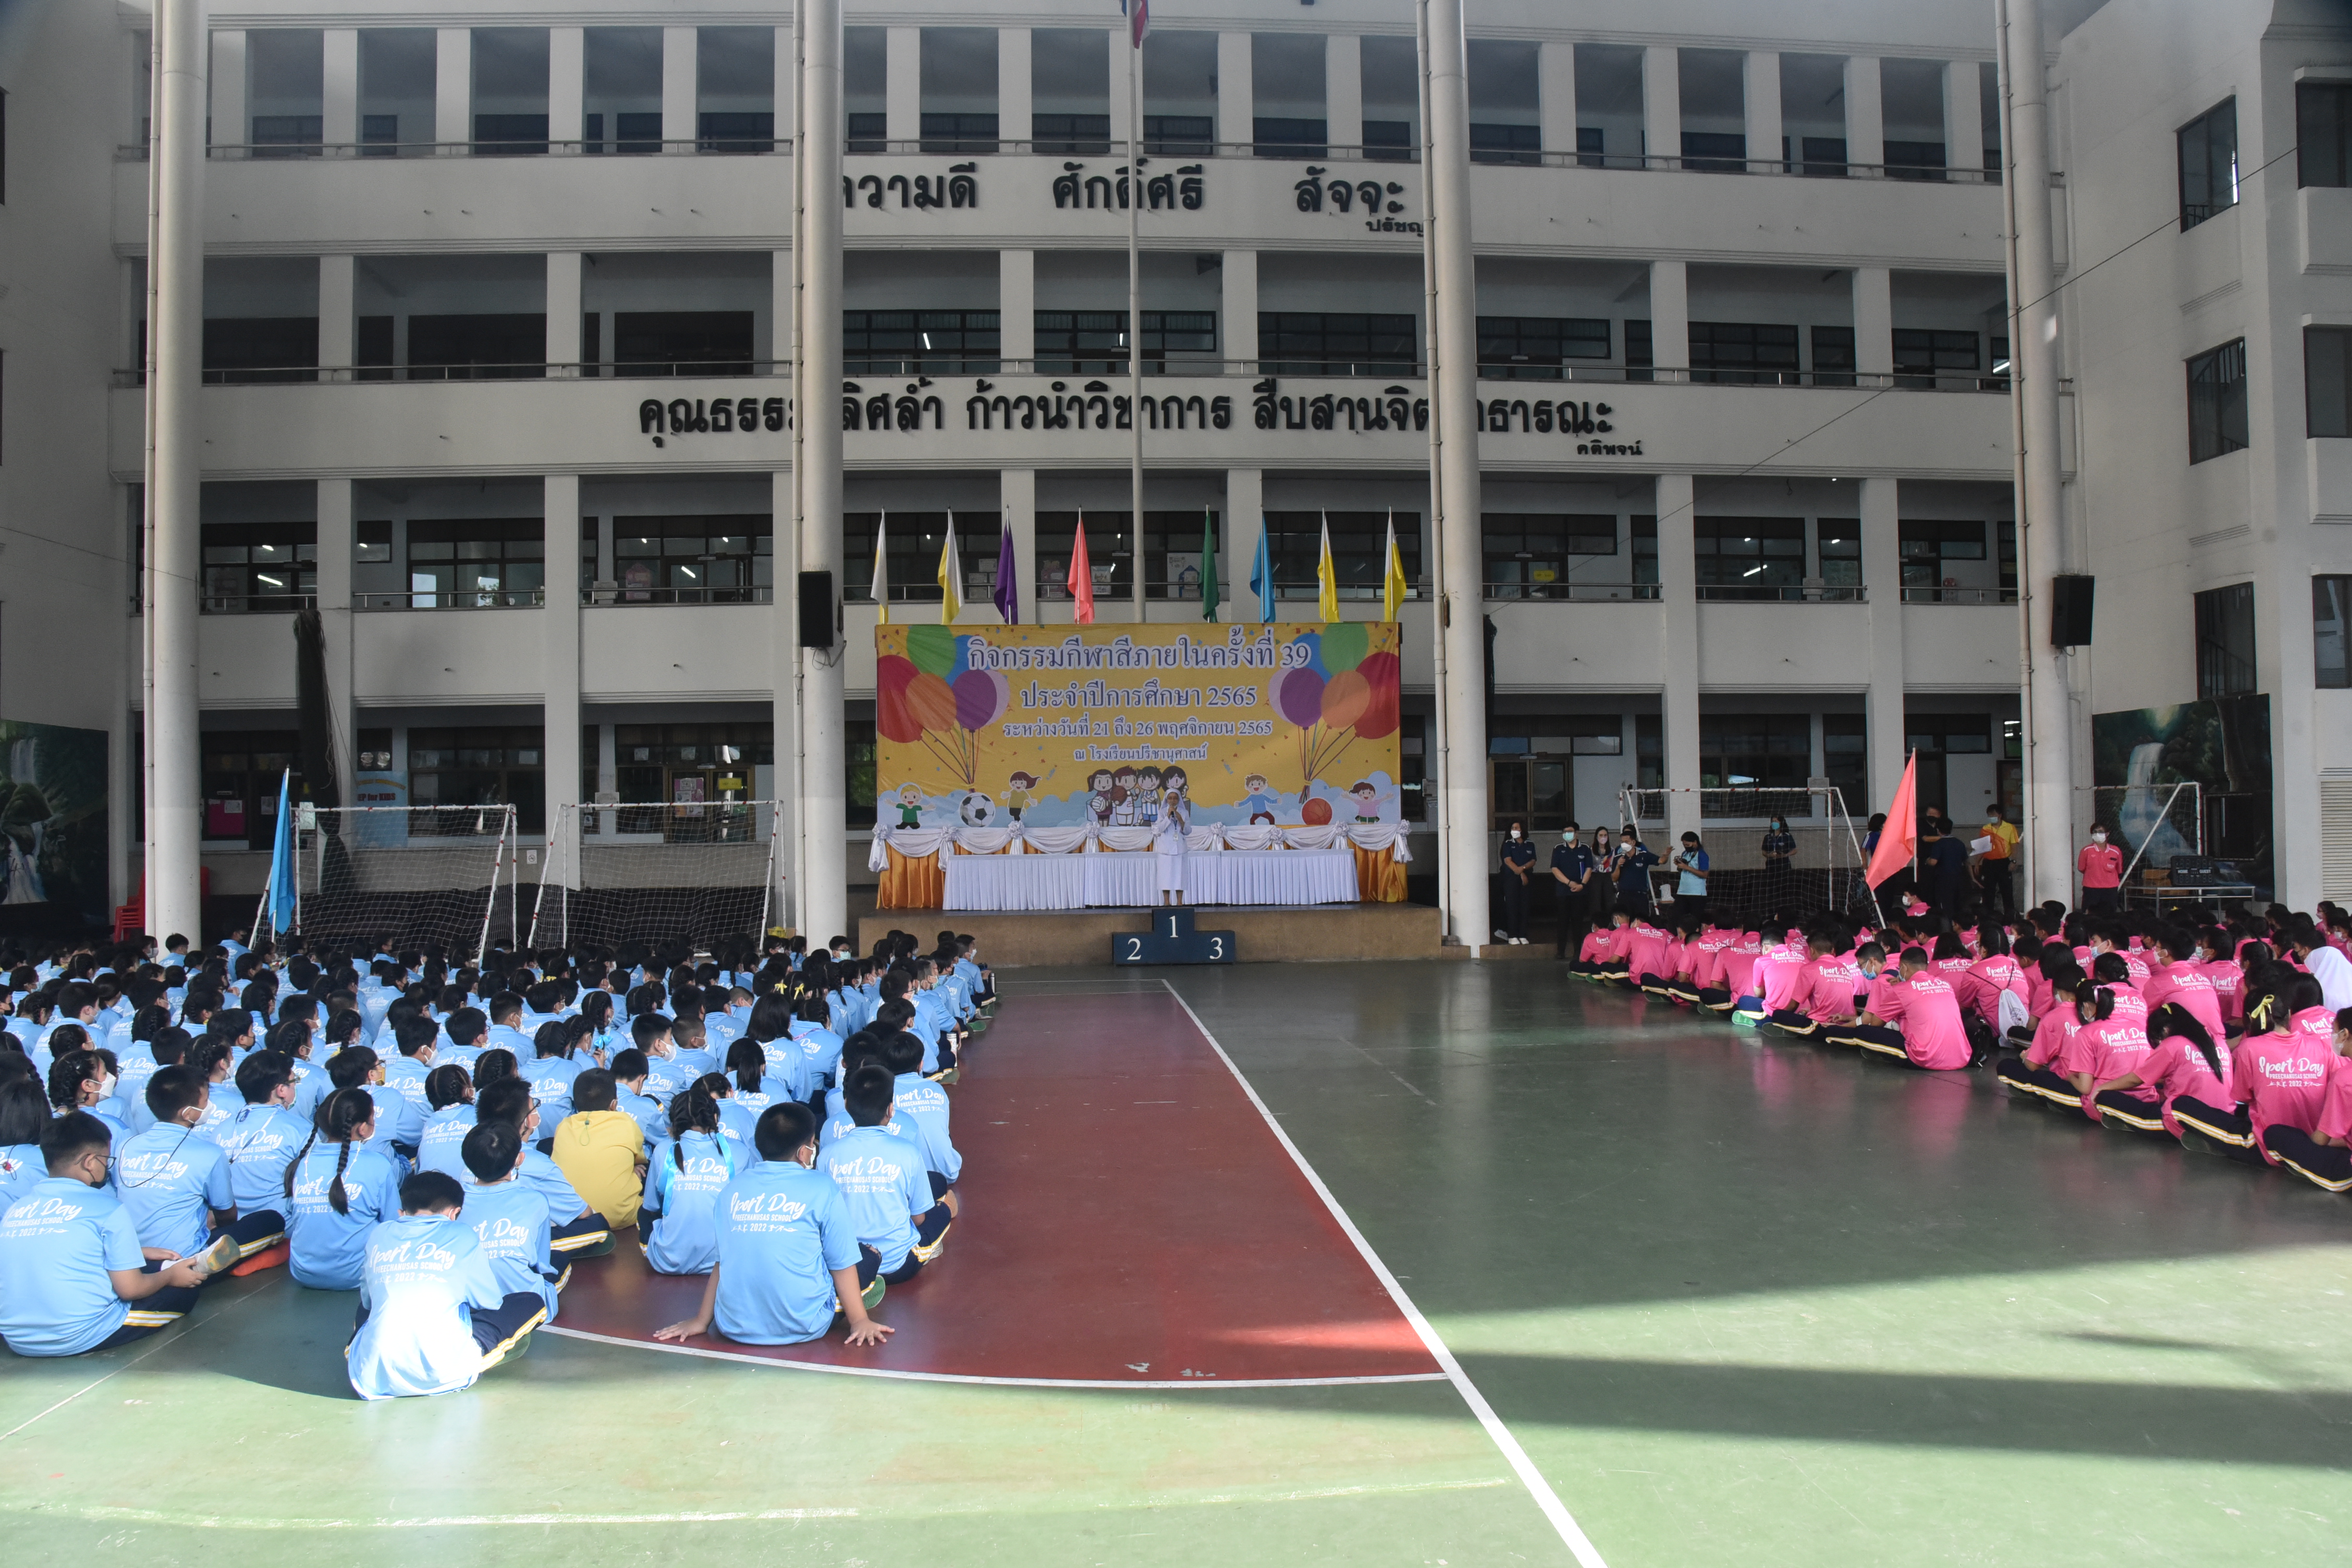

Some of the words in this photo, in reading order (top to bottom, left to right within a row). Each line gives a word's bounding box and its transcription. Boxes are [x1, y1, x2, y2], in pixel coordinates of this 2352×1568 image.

[1294, 166, 1404, 213] สัจจะ
[1365, 217, 1424, 237] ปรัชญ
[639, 376, 942, 448] คุณธรรลิศล้ำ
[966, 378, 1231, 430] ก้าวนำวิชาการ
[969, 627, 1275, 669] กิจกรรมกีฬาสีภายในครั้งที่
[1282, 644, 1310, 668] 39
[1021, 679, 1201, 707] ประจำปีการศึกษา
[1207, 686, 1257, 706] 2565
[1004, 713, 1089, 737] ระหว่างวันที่
[1093, 722, 1109, 736] 21
[1114, 718, 1132, 736] ถึง
[1135, 722, 1153, 736] 26
[1157, 718, 1234, 739] พฤศจิกายน
[1238, 721, 1272, 736] 2565
[1074, 749, 1086, 761] ณ
[1089, 742, 1208, 763] โรงเรียนปรีชานุศาสน์
[1169, 915, 1179, 938] 1
[1127, 938, 1142, 960] 2
[1209, 937, 1222, 959] 3
[1819, 965, 1840, 977] Sport
[1986, 965, 2008, 977] Sport
[1911, 980, 1934, 991] Sport
[2172, 973, 2196, 987] Sport
[2212, 975, 2232, 989] Sport
[2301, 1017, 2332, 1034] Sport
[2100, 1029, 2129, 1047] Sport
[2129, 1027, 2147, 1039] Da
[764, 1045, 787, 1061] Day
[800, 1038, 822, 1054] Day
[2185, 1045, 2204, 1064] Spo
[2215, 1046, 2230, 1060] Da
[134, 1057, 158, 1073] Day
[684, 1064, 703, 1079] Day
[2259, 1056, 2295, 1078] Sport
[2297, 1057, 2324, 1077] Day
[543, 1078, 568, 1094] Day
[648, 1073, 673, 1091] Day
[893, 1088, 921, 1107] port
[922, 1088, 945, 1105] Day
[900, 1099, 929, 1108] PREECHANUSAS
[447, 1120, 473, 1133] Day
[833, 1121, 856, 1140] Spo
[250, 1127, 284, 1149] Day
[152, 1153, 189, 1179] Day
[699, 1157, 729, 1182] Day
[829, 1156, 864, 1184] Sport
[864, 1156, 901, 1182] Day
[703, 1174, 721, 1183] SCHOOL
[836, 1175, 871, 1184] PREECHANUSAS
[872, 1175, 891, 1183] SCHOOL
[296, 1196, 329, 1204] PREECHANUSAS
[730, 1192, 766, 1220] Sport
[767, 1193, 806, 1219] Day
[40, 1197, 83, 1221] Day
[313, 1205, 328, 1214] 2022
[734, 1213, 770, 1221] PREECHANUSAS
[42, 1216, 64, 1225] SCHOOL
[750, 1223, 767, 1232] 2022
[18, 1227, 36, 1237] 2022
[493, 1218, 530, 1246] Day
[499, 1239, 520, 1247] SCHOOL
[369, 1241, 411, 1273] Sport
[415, 1242, 456, 1270] Day
[375, 1262, 418, 1275] PREECHANUSAS
[420, 1261, 444, 1271] SCHOOL
[394, 1272, 415, 1283] 2022
